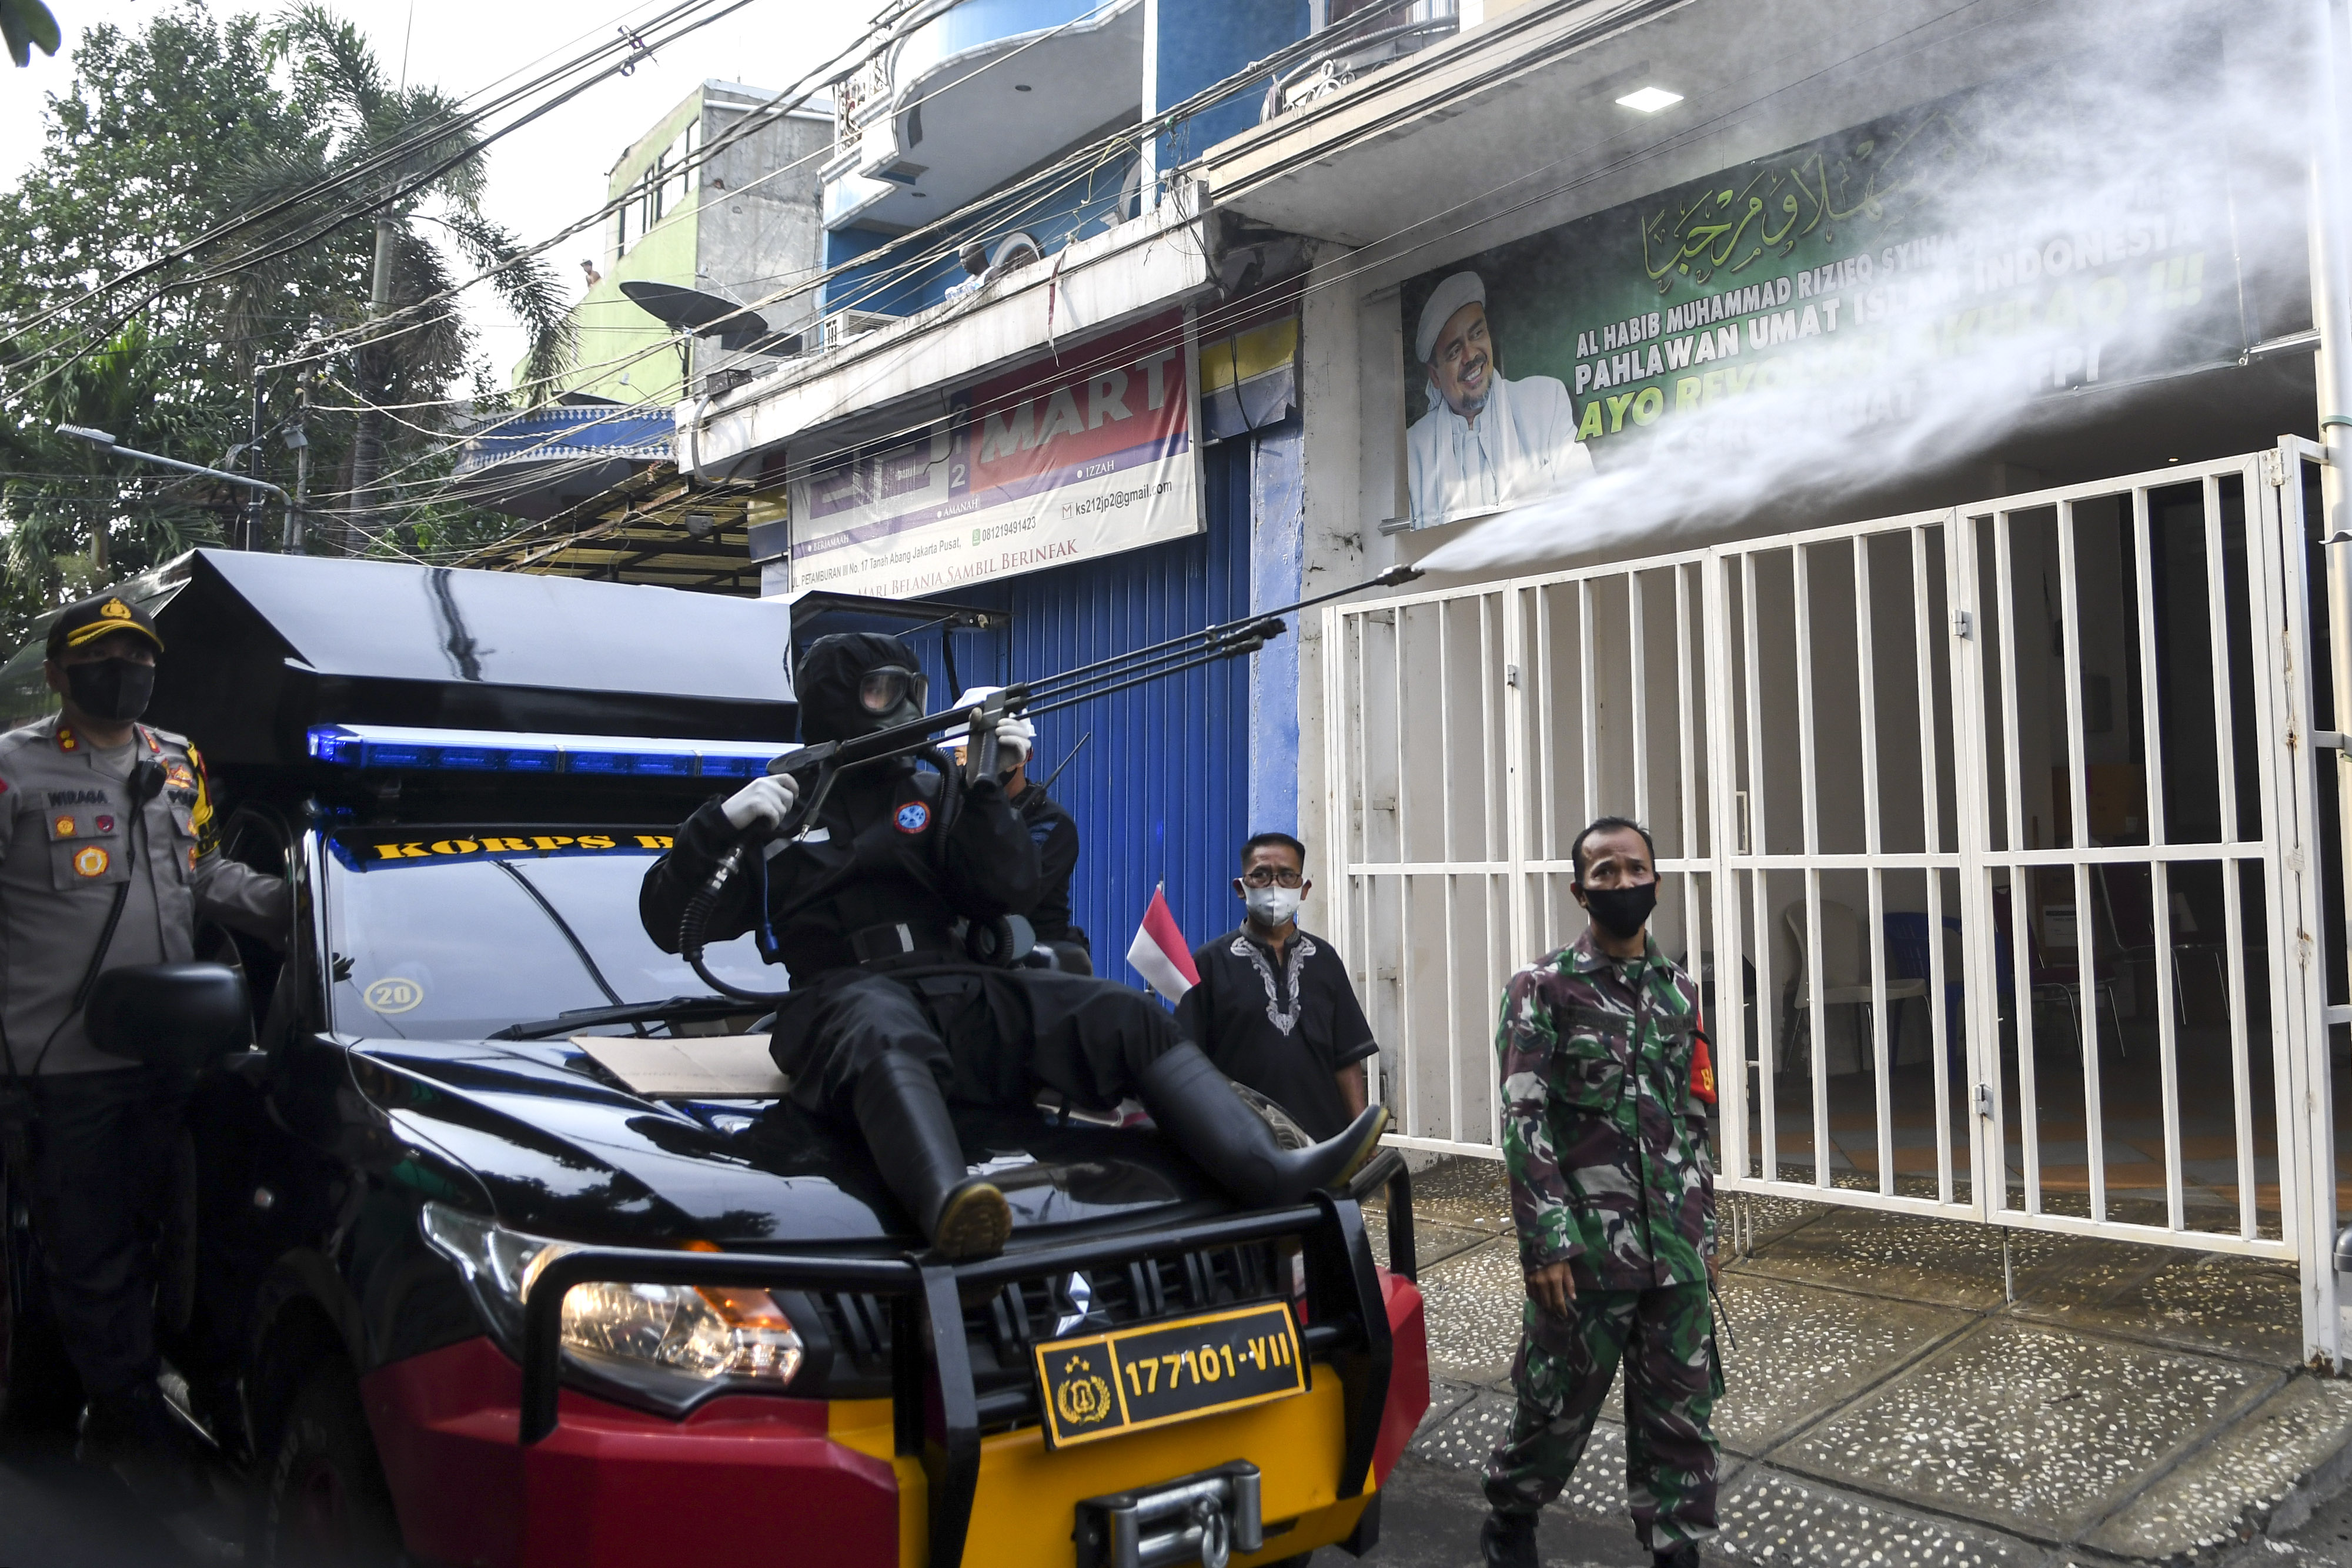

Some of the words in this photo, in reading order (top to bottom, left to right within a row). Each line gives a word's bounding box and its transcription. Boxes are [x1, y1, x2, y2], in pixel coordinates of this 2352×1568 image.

[1575, 323, 1739, 395] PAHLAWAN
[1747, 297, 1841, 350] UMAT
[1853, 266, 1960, 326] ISLAM
[1975, 214, 2202, 294] INDONESIA
[1576, 332, 1598, 360] AL
[1603, 312, 1661, 352] HABIB
[1666, 277, 1792, 336] MUHAMMAD
[1798, 253, 1873, 300] RIZIEQ
[978, 353, 1177, 464] MART
[1575, 386, 1665, 442] AYO
[1085, 460, 1114, 477] IZZAH
[943, 498, 978, 517] AMANAH
[1075, 481, 1172, 516] ks212jp2@gmail.com
[982, 516, 1037, 542] 081219491423
[801, 566, 841, 586] PETAMBURAN
[849, 562, 859, 574] No.
[861, 559, 868, 571] 17
[870, 557, 888, 569] Tanah
[890, 549, 911, 564] Abang
[913, 544, 937, 559] Jakarta
[939, 536, 961, 553] Pusat,
[947, 559, 997, 582] SAMBIL
[1001, 539, 1079, 570] BERINFAK
[373, 835, 617, 860] KORPS
[376, 986, 411, 1005] 20
